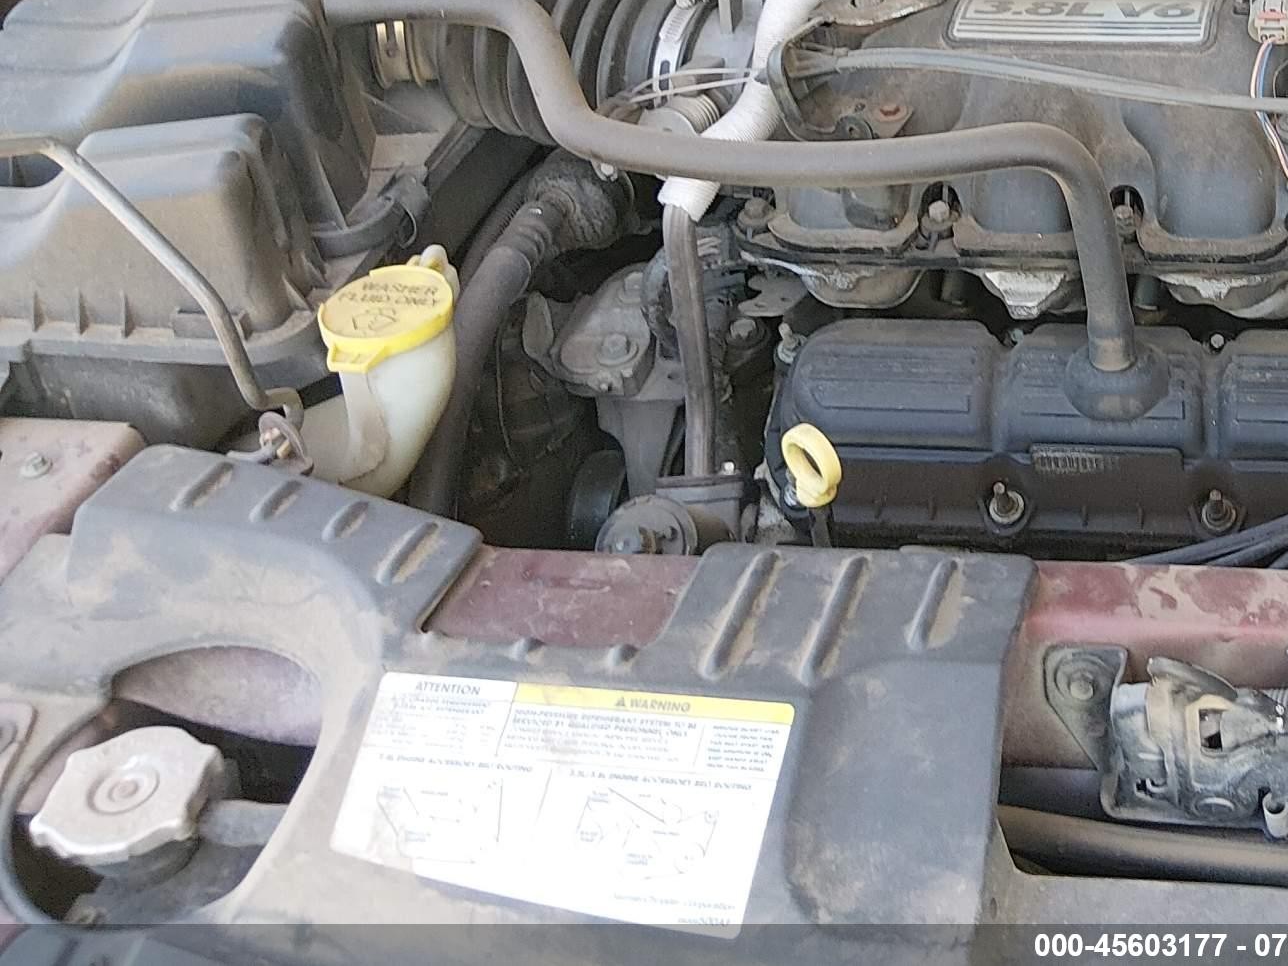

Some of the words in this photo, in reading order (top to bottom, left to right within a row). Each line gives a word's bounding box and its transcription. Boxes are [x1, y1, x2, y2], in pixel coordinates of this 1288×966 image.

[973, 0, 1104, 17] 3.8L
[1115, 0, 1196, 18] V6
[416, 681, 481, 696] ATTENTION
[630, 697, 691, 713] WARNING
